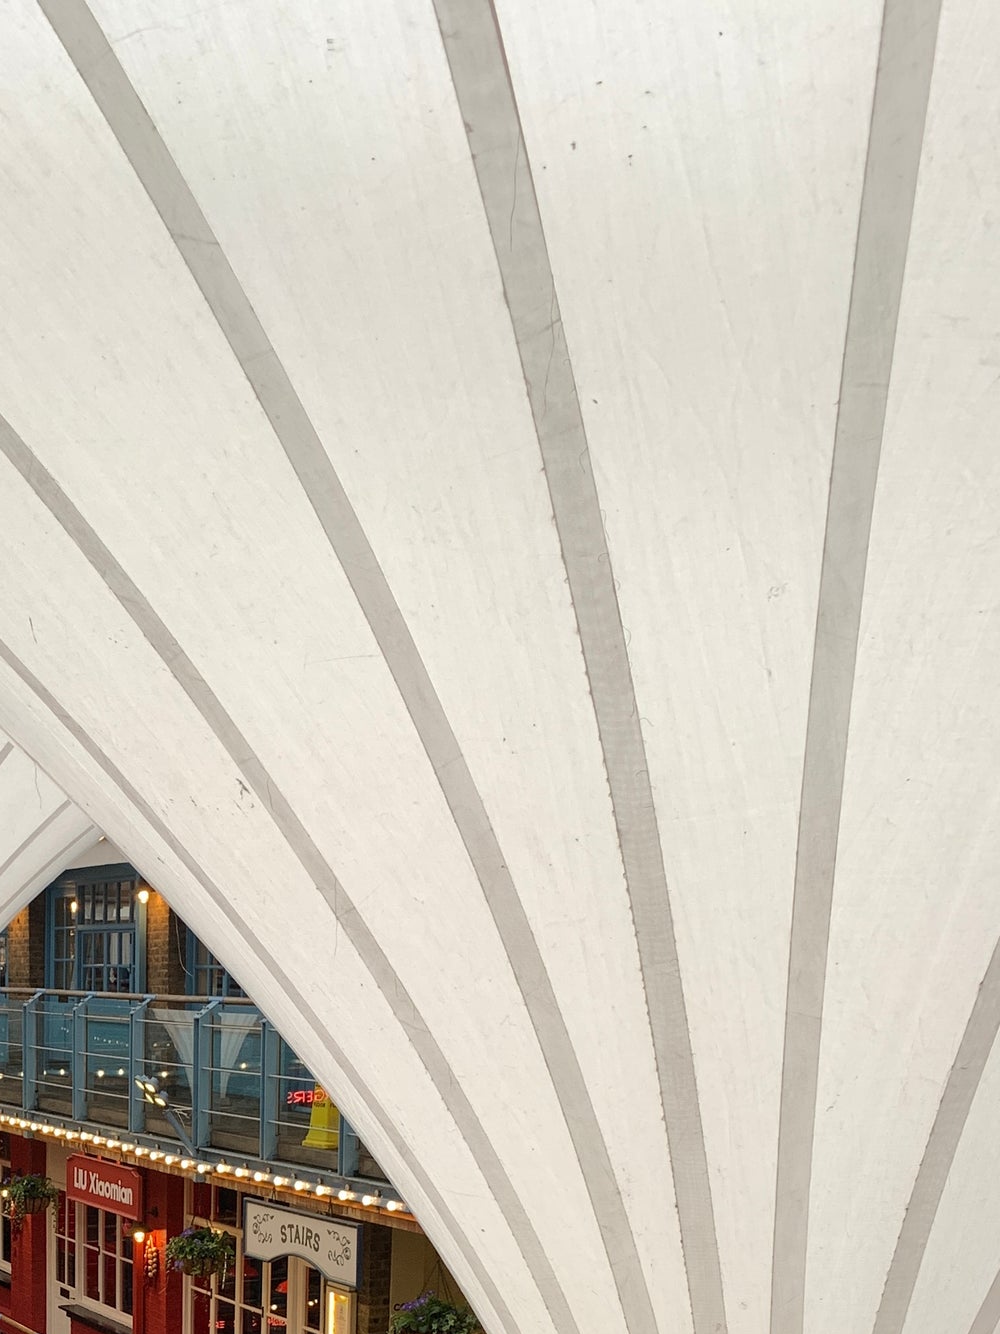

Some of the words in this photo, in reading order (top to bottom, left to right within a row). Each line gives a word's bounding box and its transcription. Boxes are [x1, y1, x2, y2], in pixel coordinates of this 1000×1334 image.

[73, 1166, 87, 1190] LIU
[89, 1172, 133, 1206] Xiaomian
[280, 1223, 321, 1252] STAIRS
